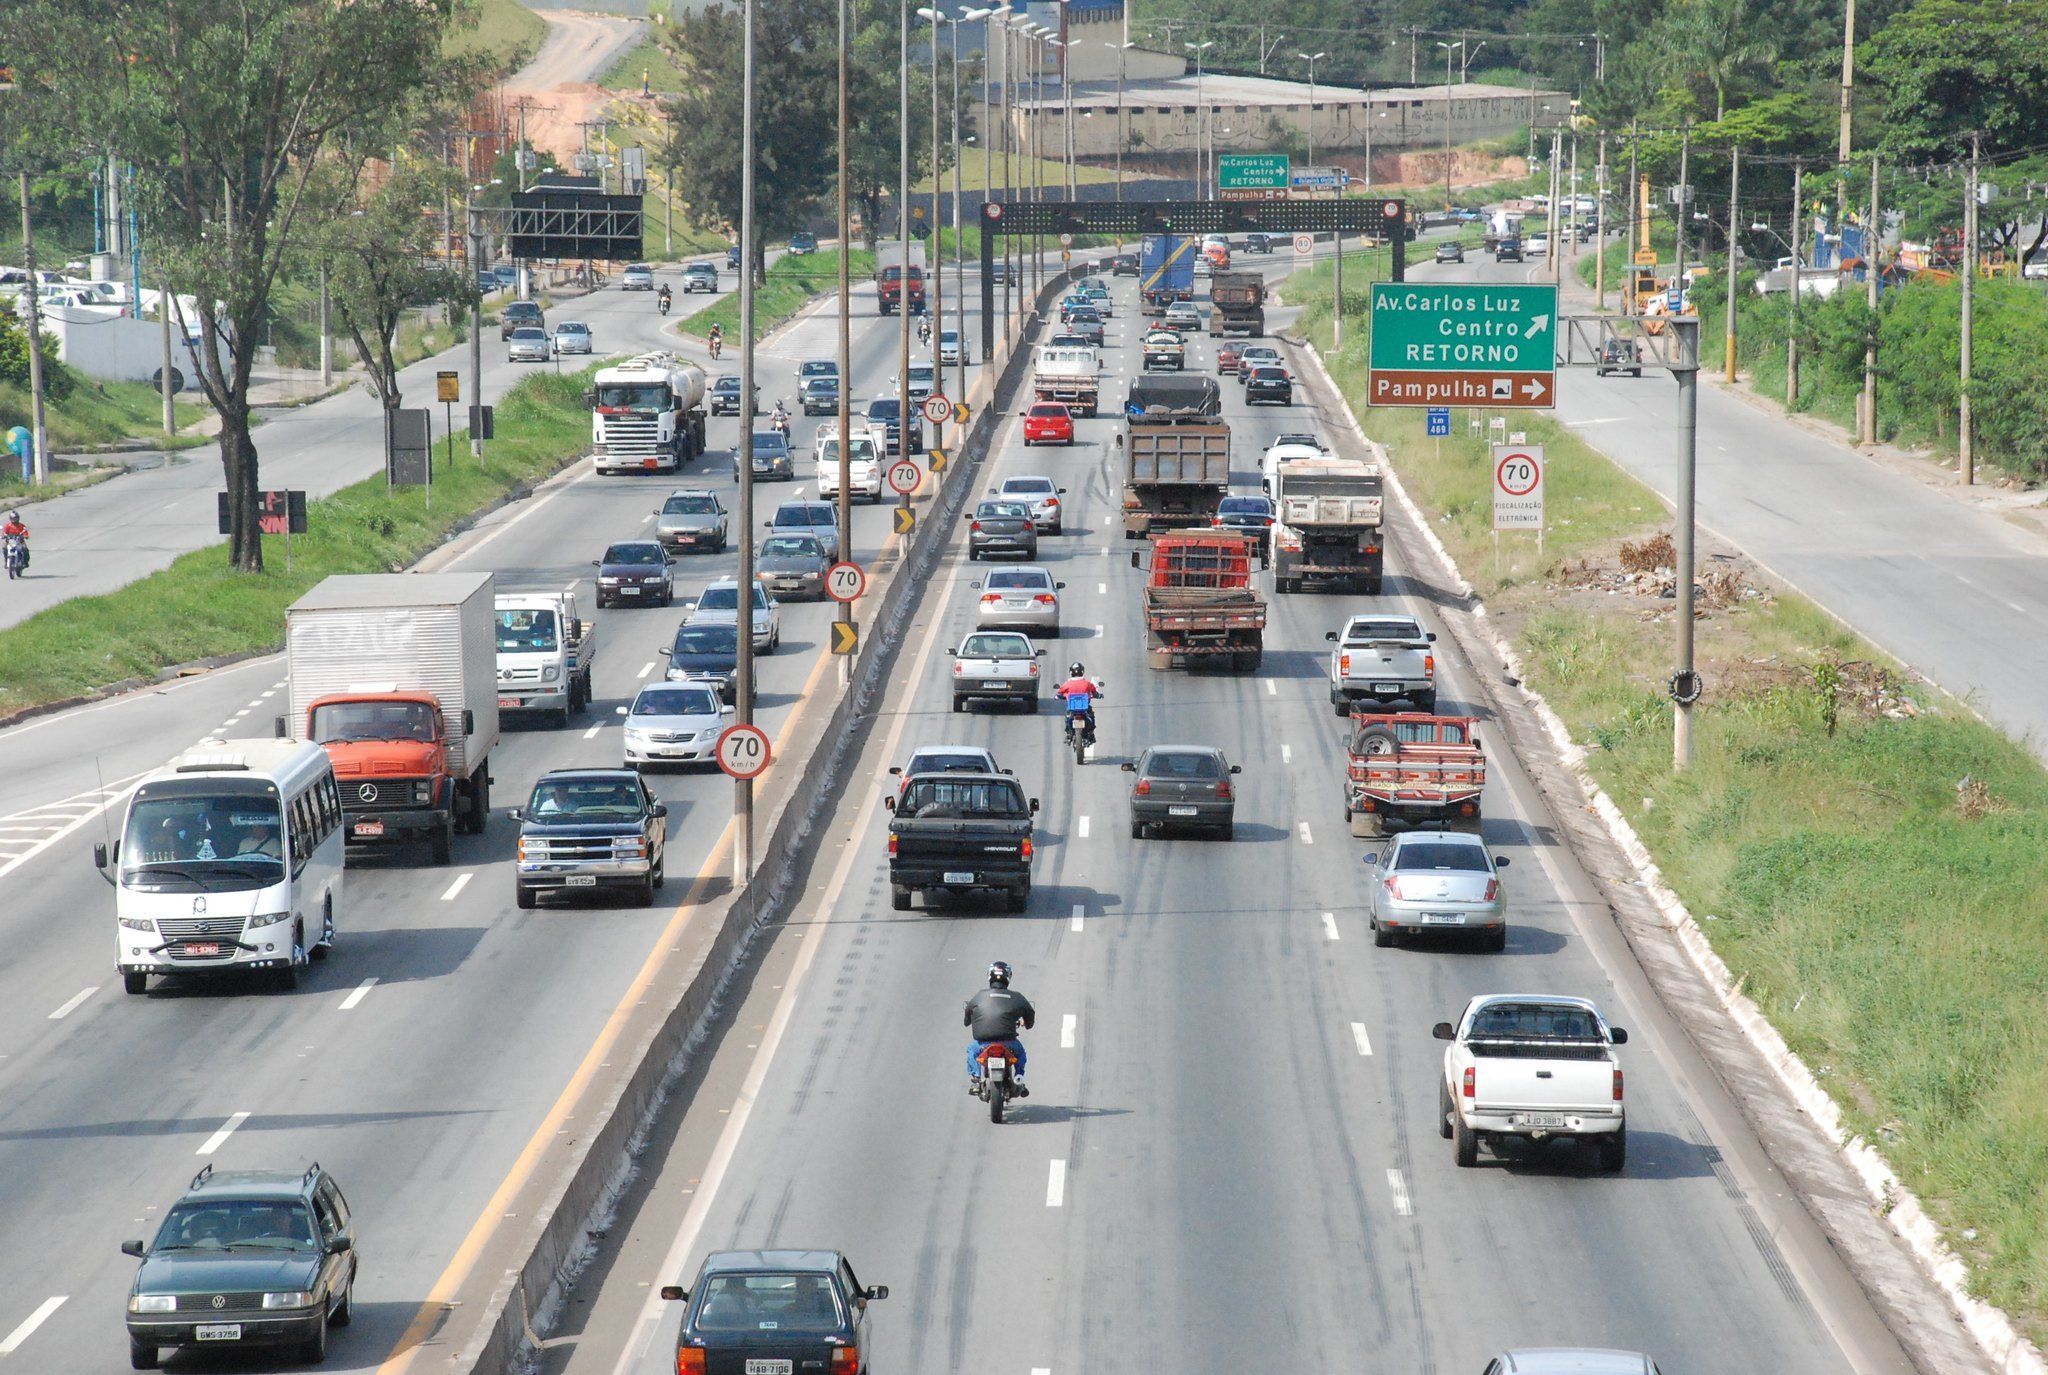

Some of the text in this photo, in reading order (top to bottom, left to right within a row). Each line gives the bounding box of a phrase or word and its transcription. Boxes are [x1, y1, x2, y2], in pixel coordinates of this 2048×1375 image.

[1230, 177, 1274, 185] RETORNO
[1221, 191, 1264, 199] Pampulha
[1484, 295, 1520, 312] Luz
[1439, 319, 1519, 336] Centro
[1406, 344, 1519, 362] RETORNO
[1377, 379, 1488, 401] Pampulha
[928, 402, 946, 415] 70
[1430, 425, 1446, 434] 469
[897, 468, 914, 480] 70
[1506, 464, 1530, 480] 70
[1495, 501, 1542, 510] FISCALIZAÇÃO
[835, 571, 857, 587] 70
[730, 737, 759, 757] 70
[731, 760, 755, 768] km/h
